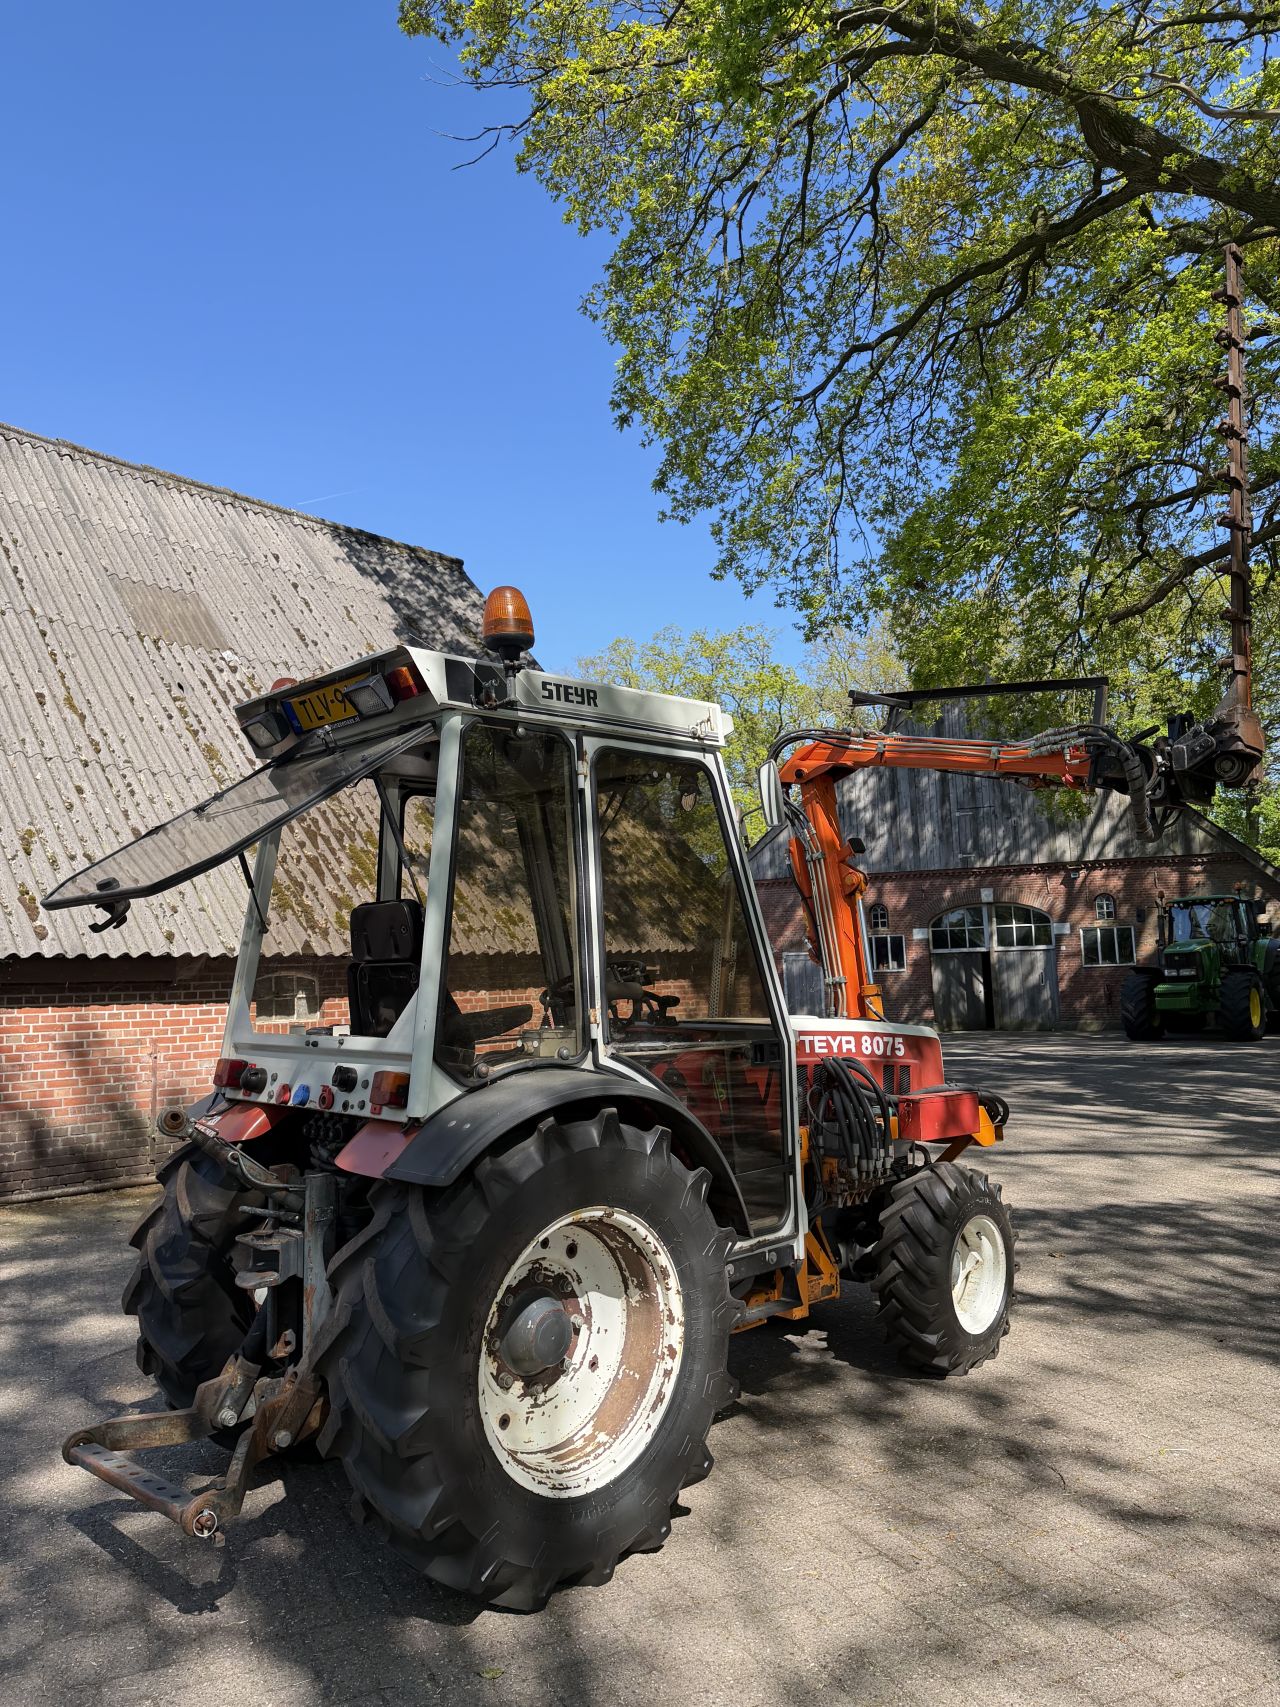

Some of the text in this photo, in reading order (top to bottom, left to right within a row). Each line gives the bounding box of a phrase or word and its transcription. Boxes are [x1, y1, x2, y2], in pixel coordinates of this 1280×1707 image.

[299, 685, 348, 723] TLV-9
[541, 681, 598, 707] STEYR
[797, 1035, 905, 1057] TEYR 8075
